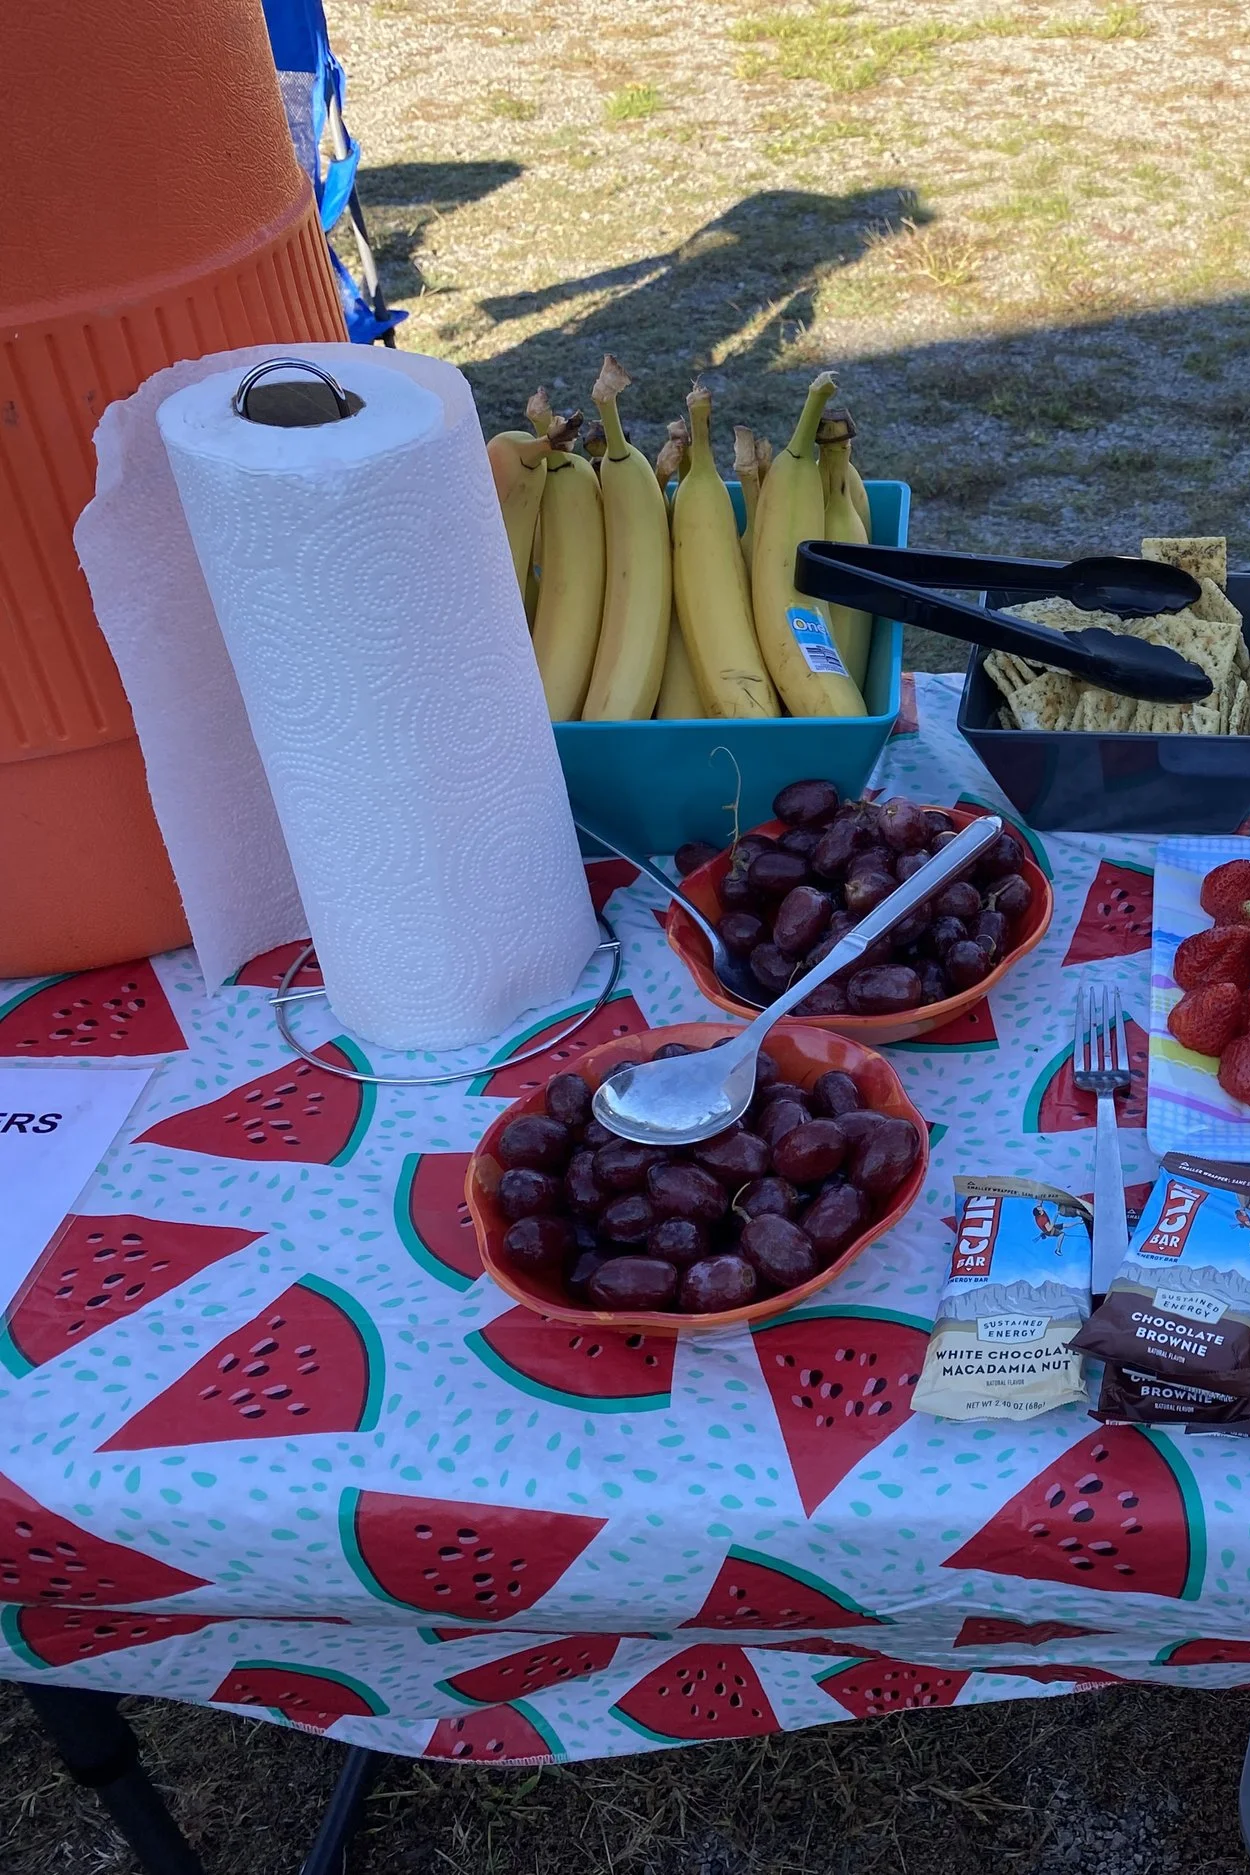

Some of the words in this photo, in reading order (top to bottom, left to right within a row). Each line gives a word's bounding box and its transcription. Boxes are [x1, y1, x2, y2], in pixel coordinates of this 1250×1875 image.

[1159, 1182, 1202, 1233] CLIF
[959, 1196, 996, 1254] CLIF
[1149, 1234, 1181, 1248] BAR
[956, 1256, 985, 1269] BAR
[1161, 1293, 1220, 1313] SUSTAINED
[1163, 1301, 1212, 1319] ENERGY
[983, 1318, 1043, 1330] SUSTAINED
[1131, 1312, 1225, 1346] CHOCOLATE
[987, 1328, 1036, 1338] ENERGY
[1135, 1326, 1208, 1357] BROWNIE
[936, 1350, 983, 1361] WHITE
[1147, 1346, 1167, 1360] NATURAL
[1168, 1351, 1186, 1364] FLAVOR
[942, 1363, 1037, 1376] MACADAMIA
[1041, 1360, 1071, 1373] NUT
[986, 1379, 1006, 1387] NATURAL
[1008, 1378, 1025, 1386] FLAVOR
[1141, 1386, 1212, 1404] BROWNIE
[966, 1400, 981, 1409] NET
[982, 1400, 994, 1409] WT
[1013, 1402, 1024, 1411] OZ
[1154, 1402, 1175, 1411] NATURAL
[1176, 1404, 1194, 1413] FLAVOR
